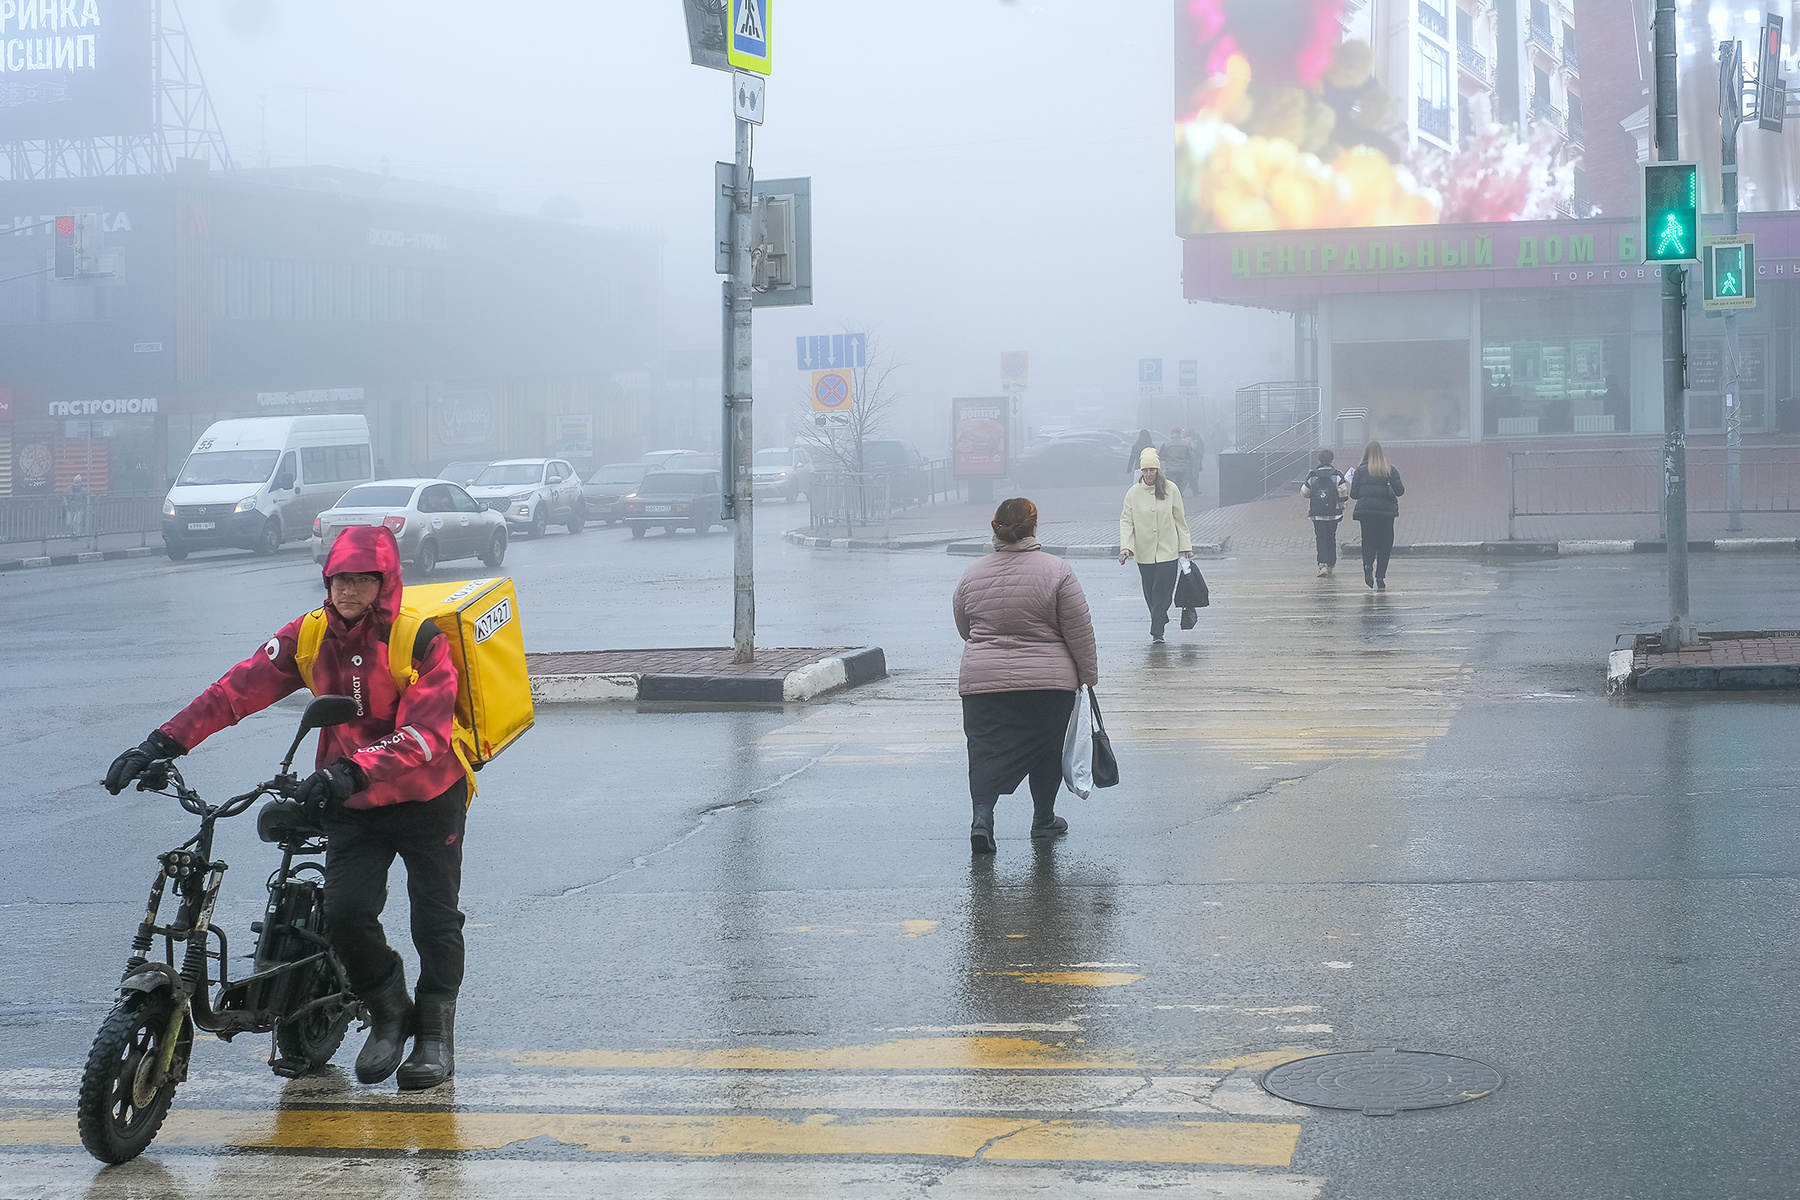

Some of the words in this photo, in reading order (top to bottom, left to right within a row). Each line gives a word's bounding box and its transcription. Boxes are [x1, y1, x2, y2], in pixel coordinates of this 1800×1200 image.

[1232, 233, 1492, 279] ЦЕНТРАЛЬНЫЙ
[1517, 235, 1594, 268] ДОМ
[49, 397, 159, 416] ГАСТРОНОМ
[960, 409, 1000, 421] ВОППЕР
[198, 439, 214, 450] 55
